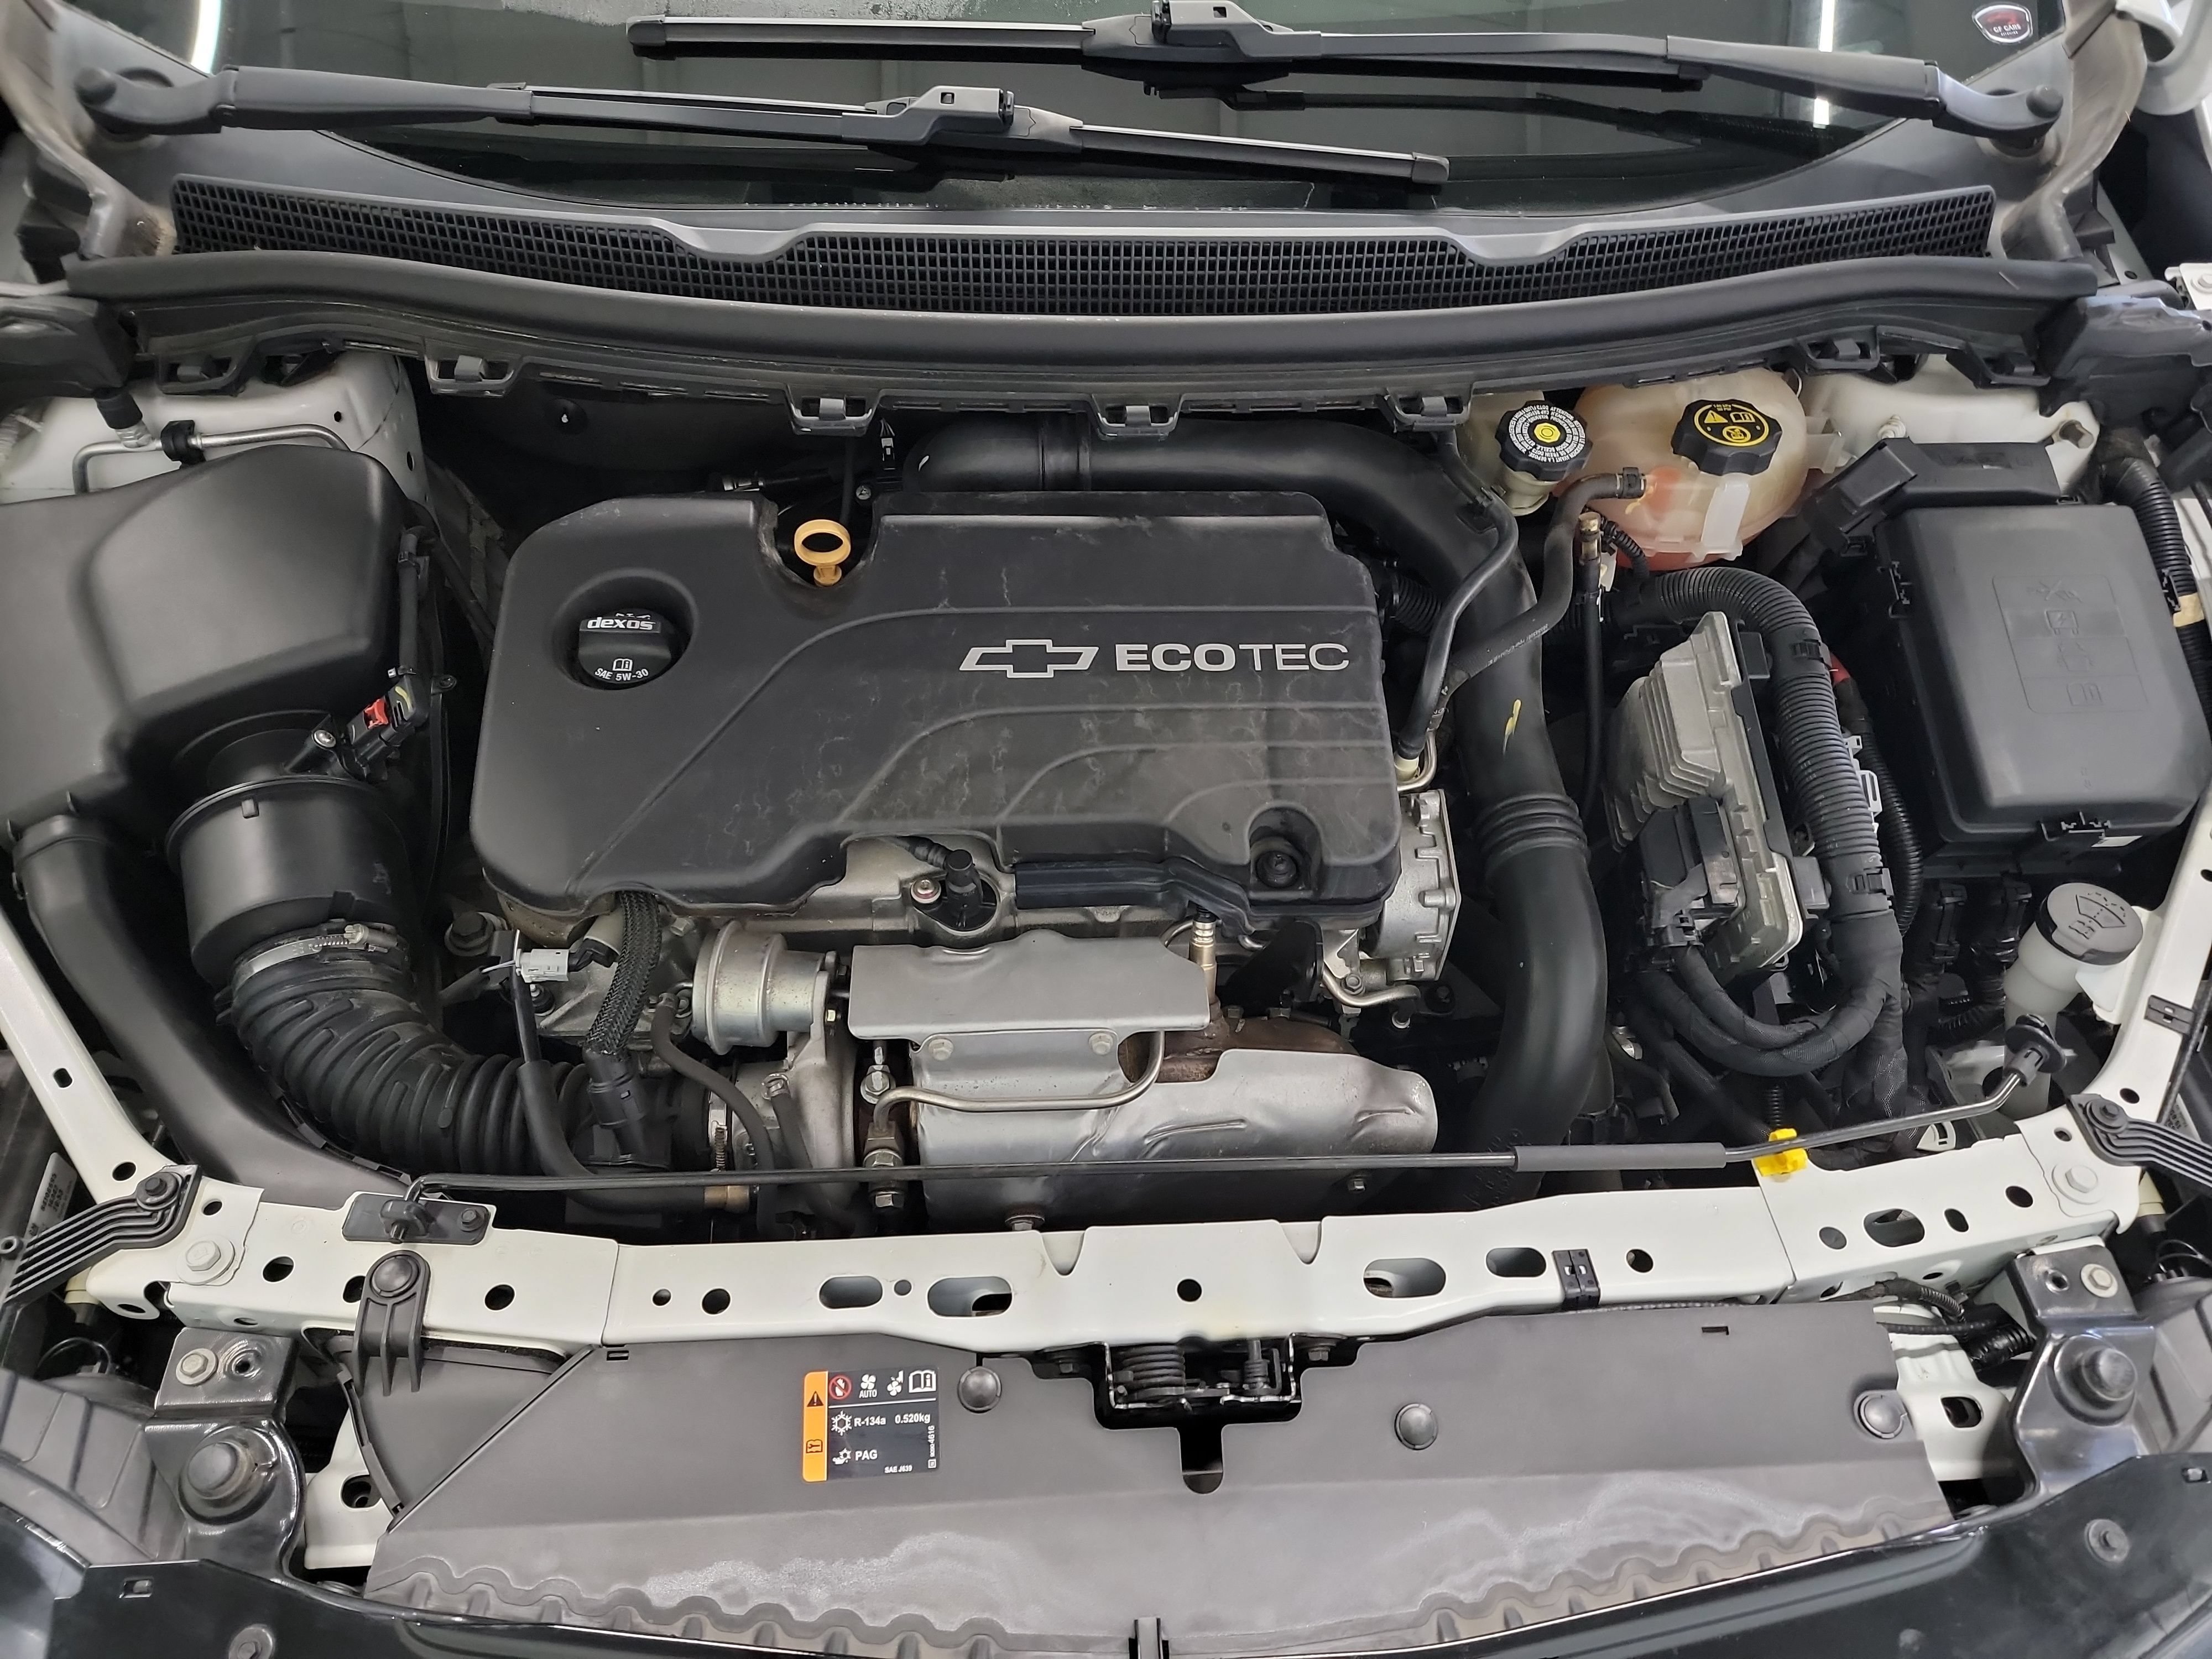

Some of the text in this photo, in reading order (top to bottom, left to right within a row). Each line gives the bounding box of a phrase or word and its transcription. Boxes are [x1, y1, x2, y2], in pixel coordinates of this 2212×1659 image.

[587, 617, 655, 630] dexos
[1115, 643, 1350, 672] ECOTEC
[594, 668, 649, 681] SAE 5W-30
[859, 1389, 878, 1399] AUTO
[854, 1412, 931, 1427] R-134a 0.520kg
[855, 1449, 878, 1460] PAG
